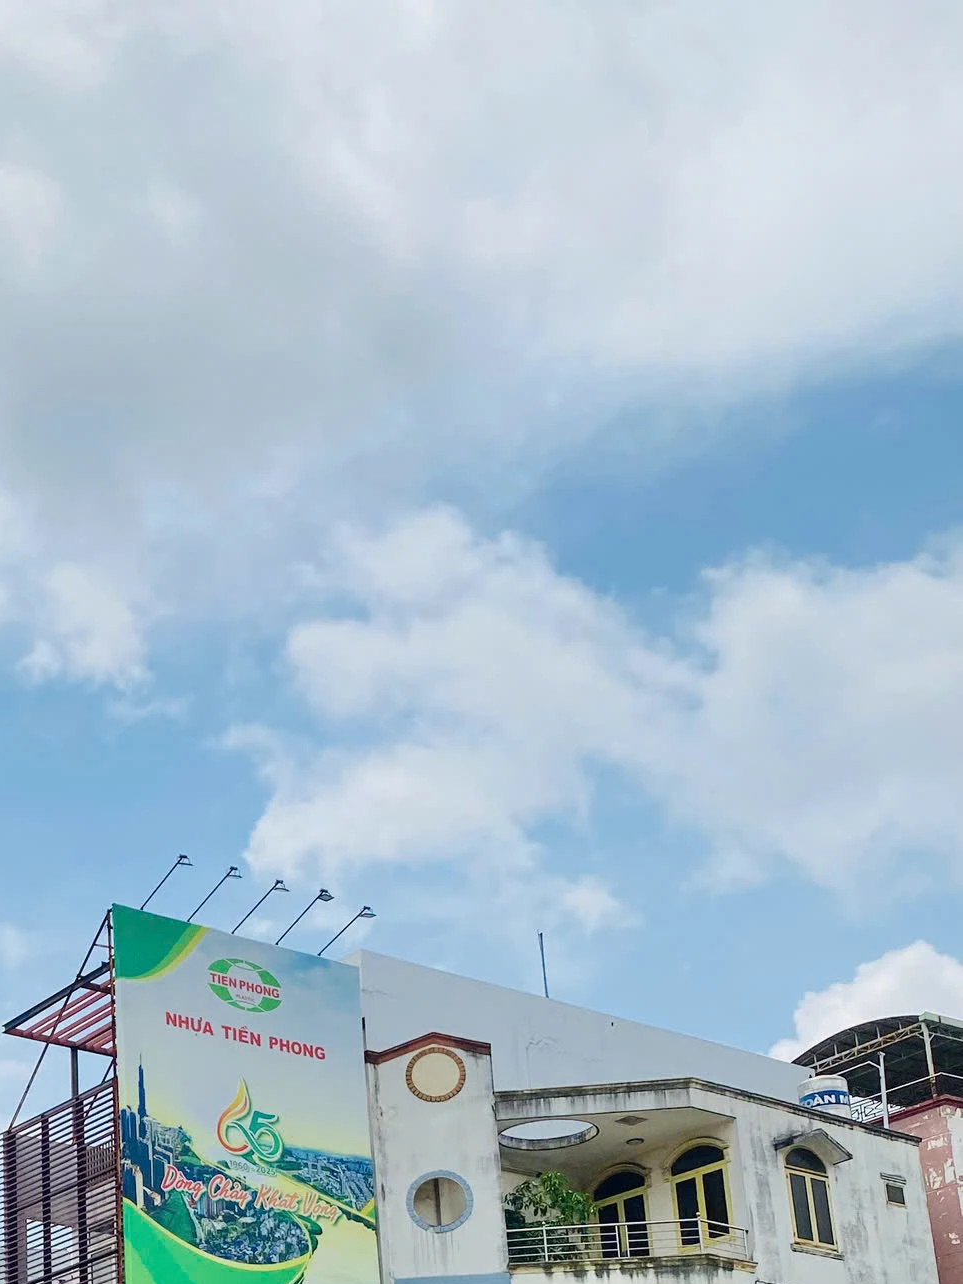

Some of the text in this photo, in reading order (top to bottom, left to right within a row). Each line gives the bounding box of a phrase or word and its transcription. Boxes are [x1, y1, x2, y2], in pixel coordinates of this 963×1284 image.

[239, 980, 280, 998] PHONG
[165, 1012, 325, 1060] NHỰA TIỀN PHONG
[229, 1160, 276, 1176] 1960 2025
[162, 1166, 204, 1197] Dòng
[209, 1175, 250, 1208] Chảy
[303, 1192, 340, 1222] Vọng
